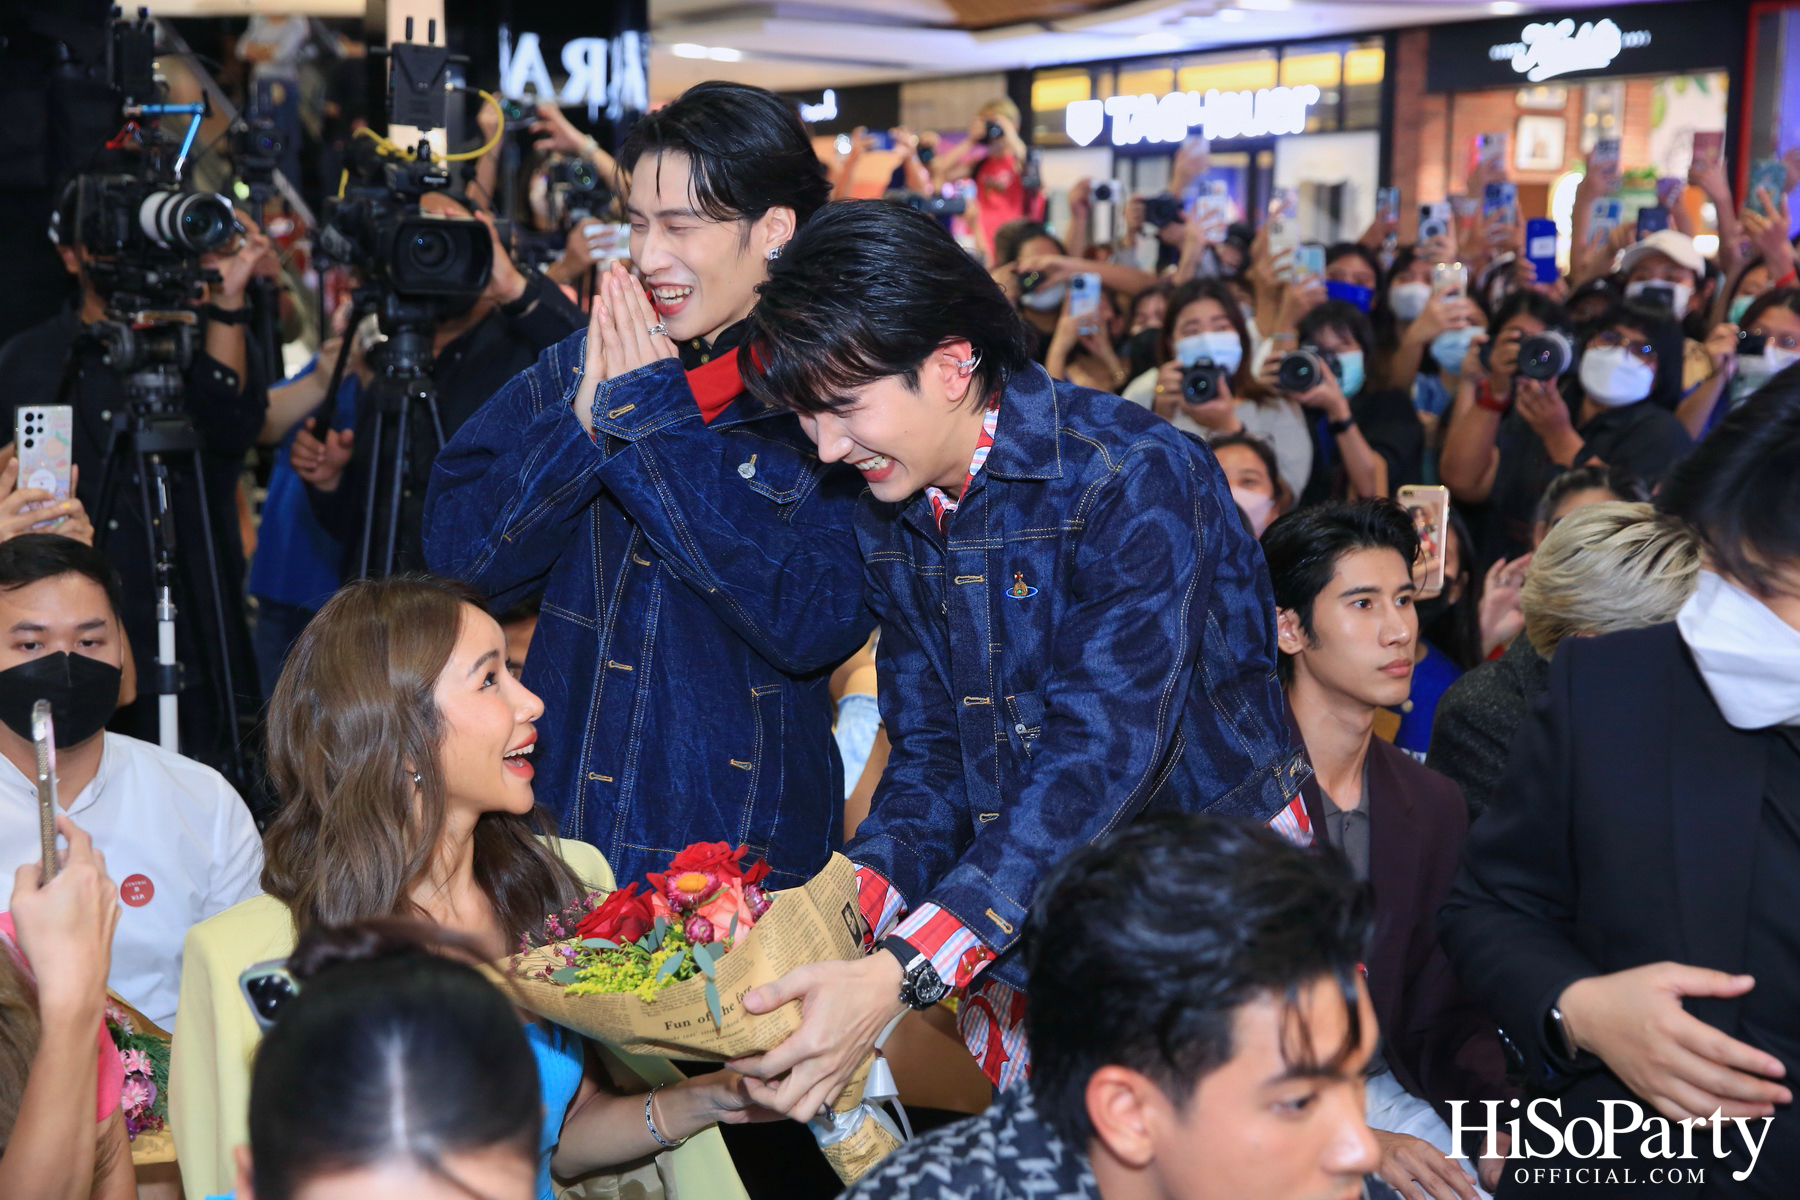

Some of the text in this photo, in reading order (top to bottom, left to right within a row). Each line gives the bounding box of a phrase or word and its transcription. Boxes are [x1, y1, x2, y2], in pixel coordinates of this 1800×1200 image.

[664, 1019, 691, 1031] Fun
[698, 1010, 712, 1024] of
[720, 1002, 735, 1017] he
